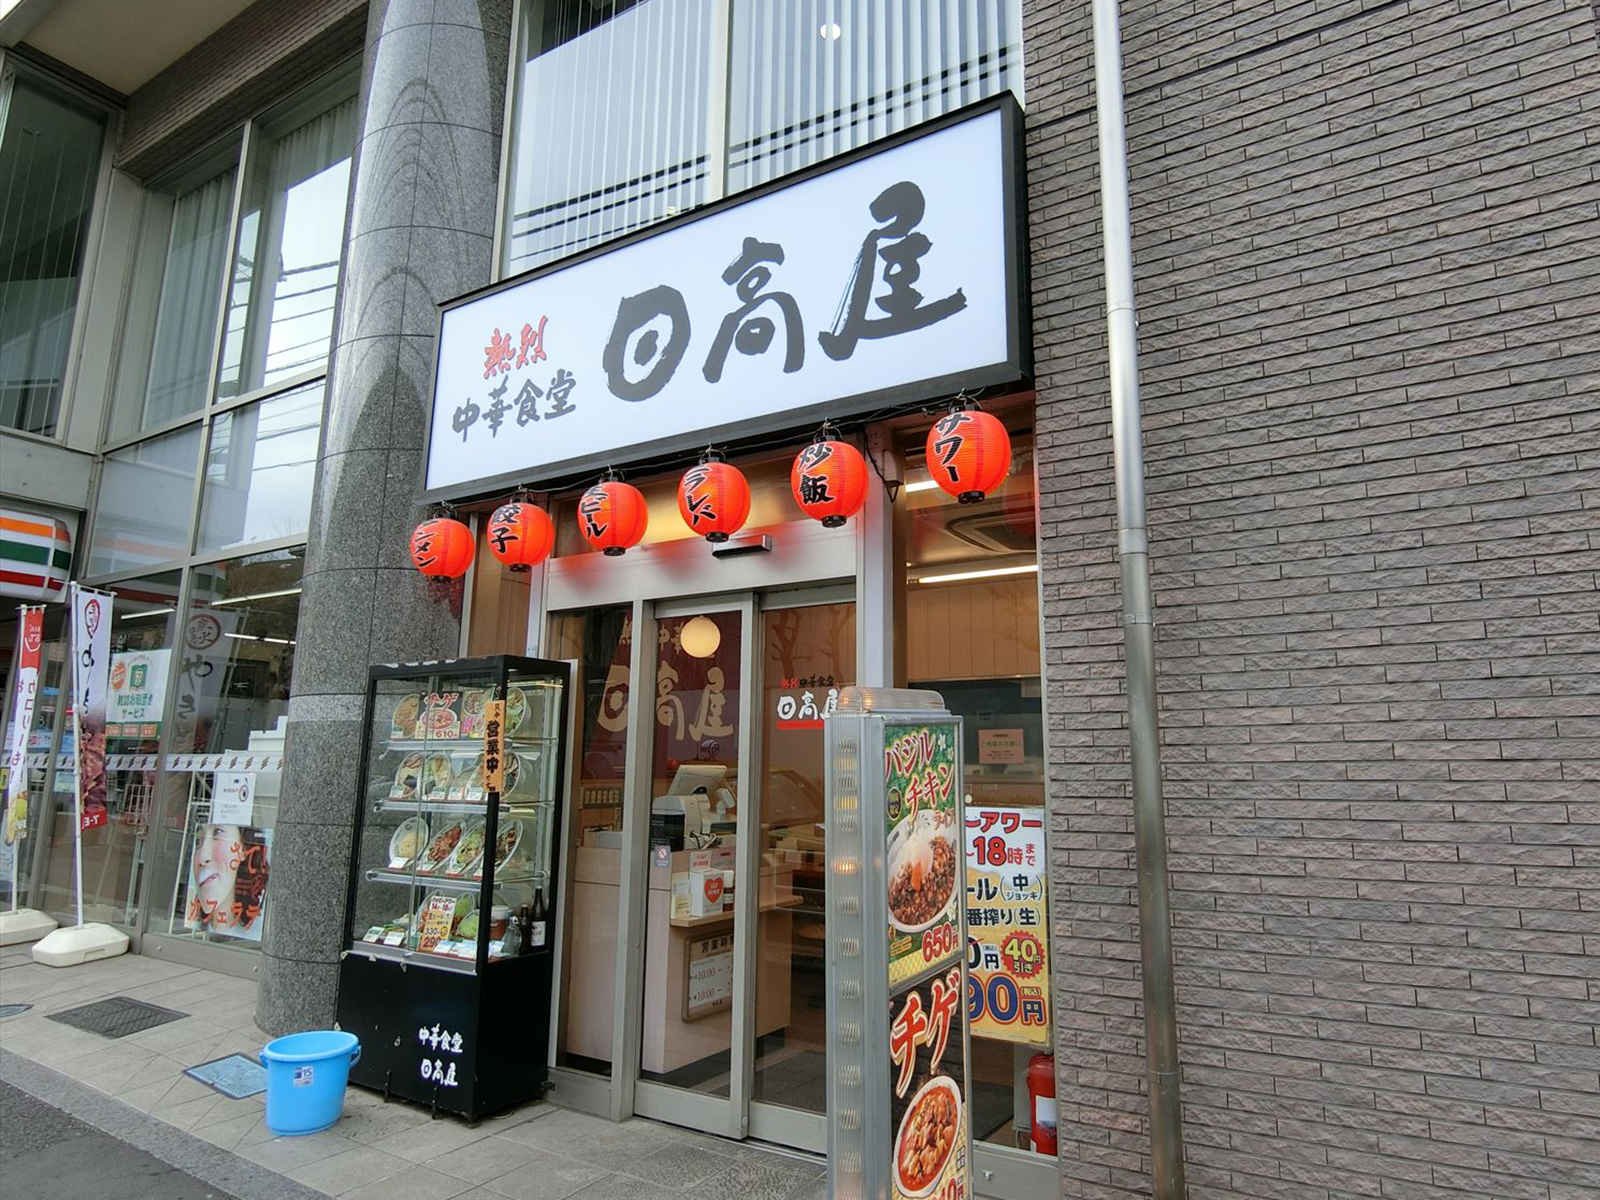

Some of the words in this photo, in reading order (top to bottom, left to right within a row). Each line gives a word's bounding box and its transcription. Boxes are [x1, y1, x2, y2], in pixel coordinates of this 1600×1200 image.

[602, 181, 967, 402] 日高屋
[483, 315, 548, 380] 熱烈
[452, 368, 577, 443] 中華食堂
[797, 443, 835, 505] 炒飯
[935, 413, 972, 483] サワー
[490, 504, 522, 554] 餃子
[486, 719, 501, 775] 営業中
[885, 729, 936, 781] バジル
[904, 763, 955, 824] チキン
[189, 899, 262, 932] カフェラテ
[922, 922, 959, 963] 650円
[418, 1022, 463, 1053] 中華食堂
[890, 967, 962, 1099] チゲ
[421, 1058, 459, 1087] 日高屋
